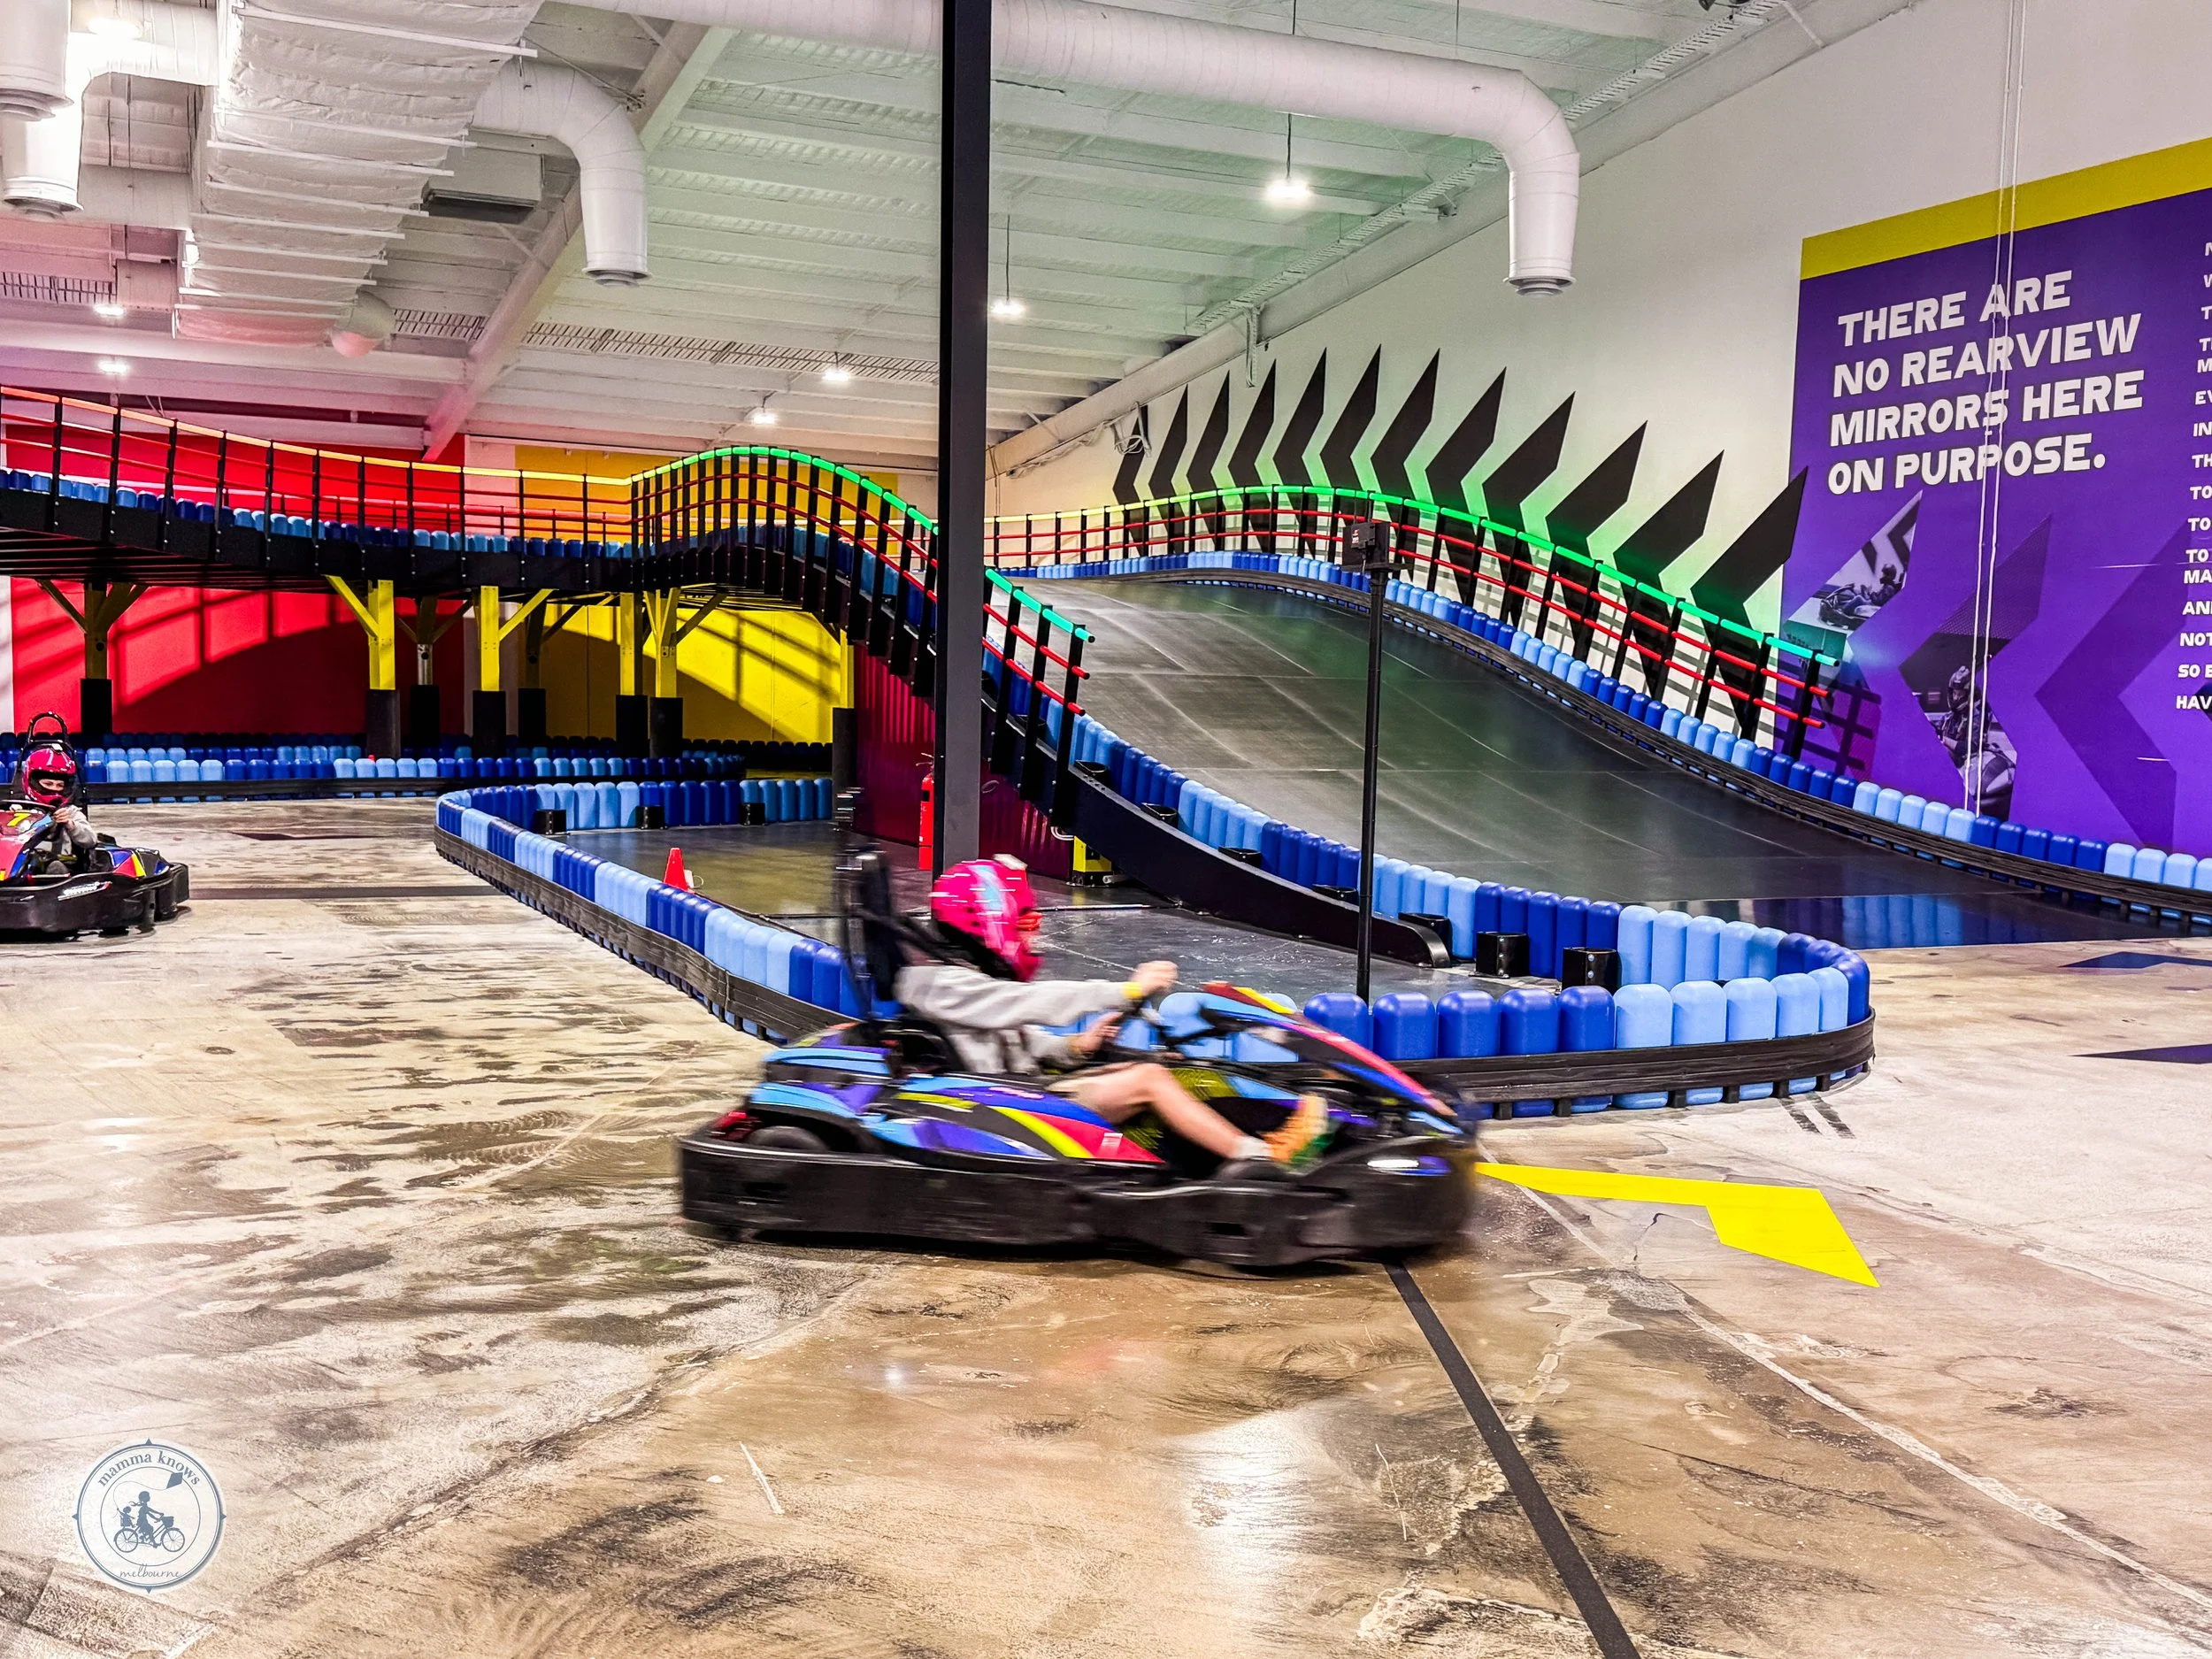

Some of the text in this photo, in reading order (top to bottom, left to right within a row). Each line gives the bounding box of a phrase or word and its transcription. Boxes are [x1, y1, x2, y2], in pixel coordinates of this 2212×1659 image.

[1838, 270, 2072, 347] THERE ARE
[1833, 313, 2142, 398] NO REARVIEW
[1830, 370, 2145, 447] MIRRORS HERE
[1827, 433, 2106, 495] ON PURPOSE.
[2190, 485, 2212, 500] TO
[2187, 517, 2211, 532] TO
[2185, 549, 2209, 564] TO
[2177, 664, 2201, 679] SO
[2176, 695, 2212, 710] HAV
[7, 811, 32, 827] 7
